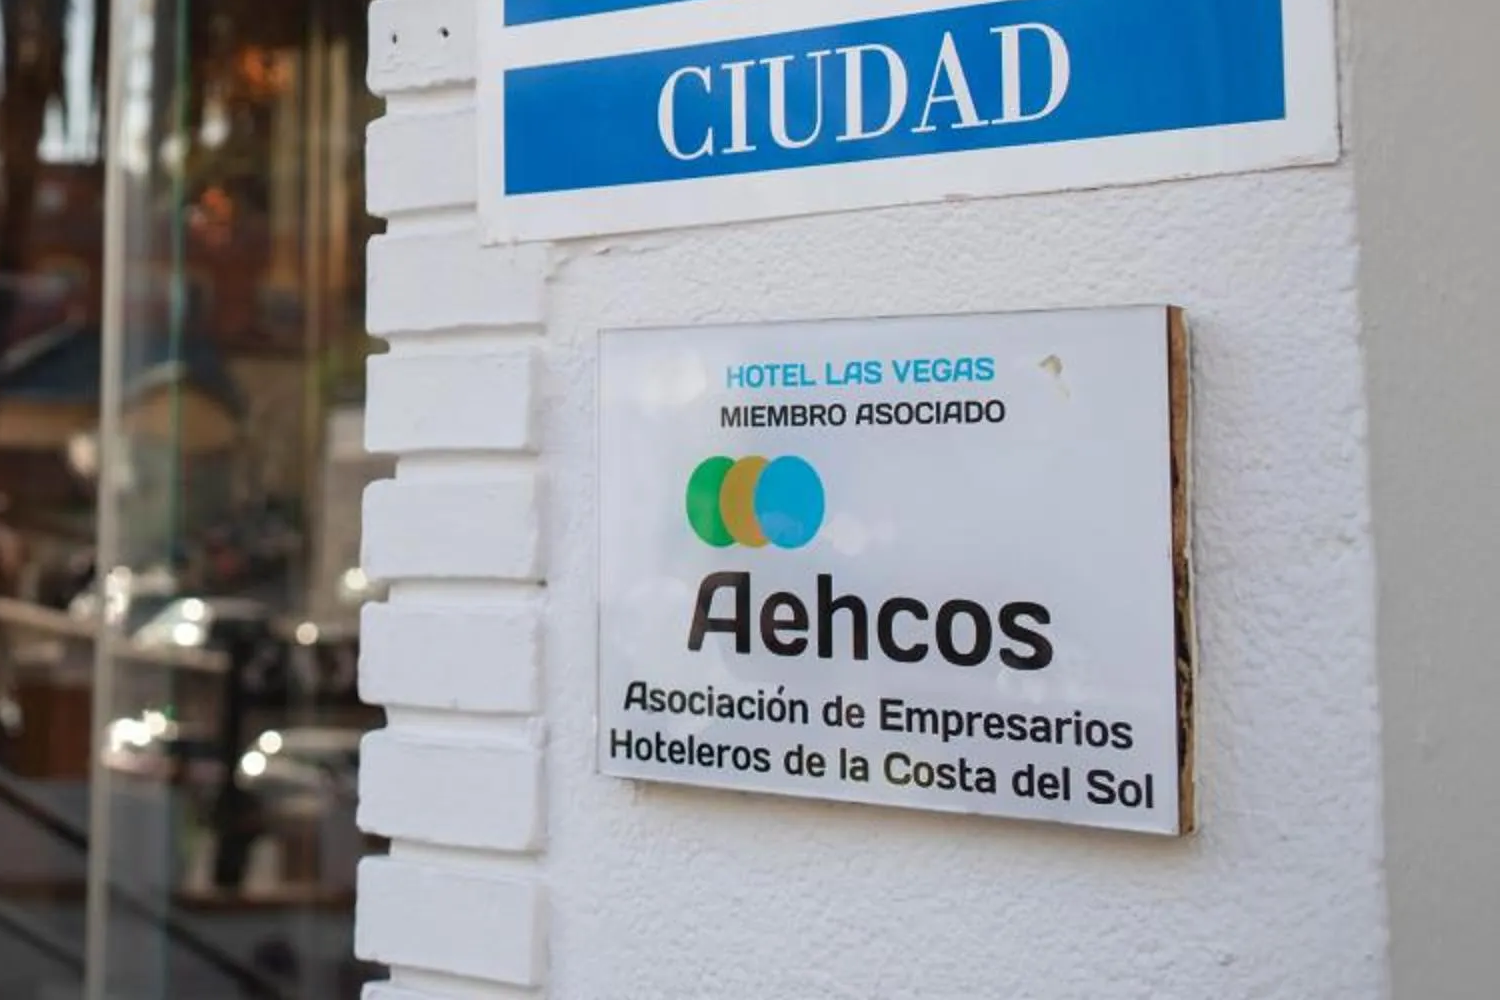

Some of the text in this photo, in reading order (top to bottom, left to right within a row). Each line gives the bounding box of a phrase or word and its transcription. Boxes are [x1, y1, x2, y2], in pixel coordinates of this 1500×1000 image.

[656, 21, 1071, 161] CIUDAD
[726, 355, 996, 389] HOTEL LAS VEGAS
[720, 399, 1006, 428] MIEMBRO ASOCIADO
[687, 570, 1054, 671] Aehcos
[623, 680, 1134, 751] Asociación de Empresarios
[609, 727, 1154, 809] Hoteleros de la Costa del Sol
